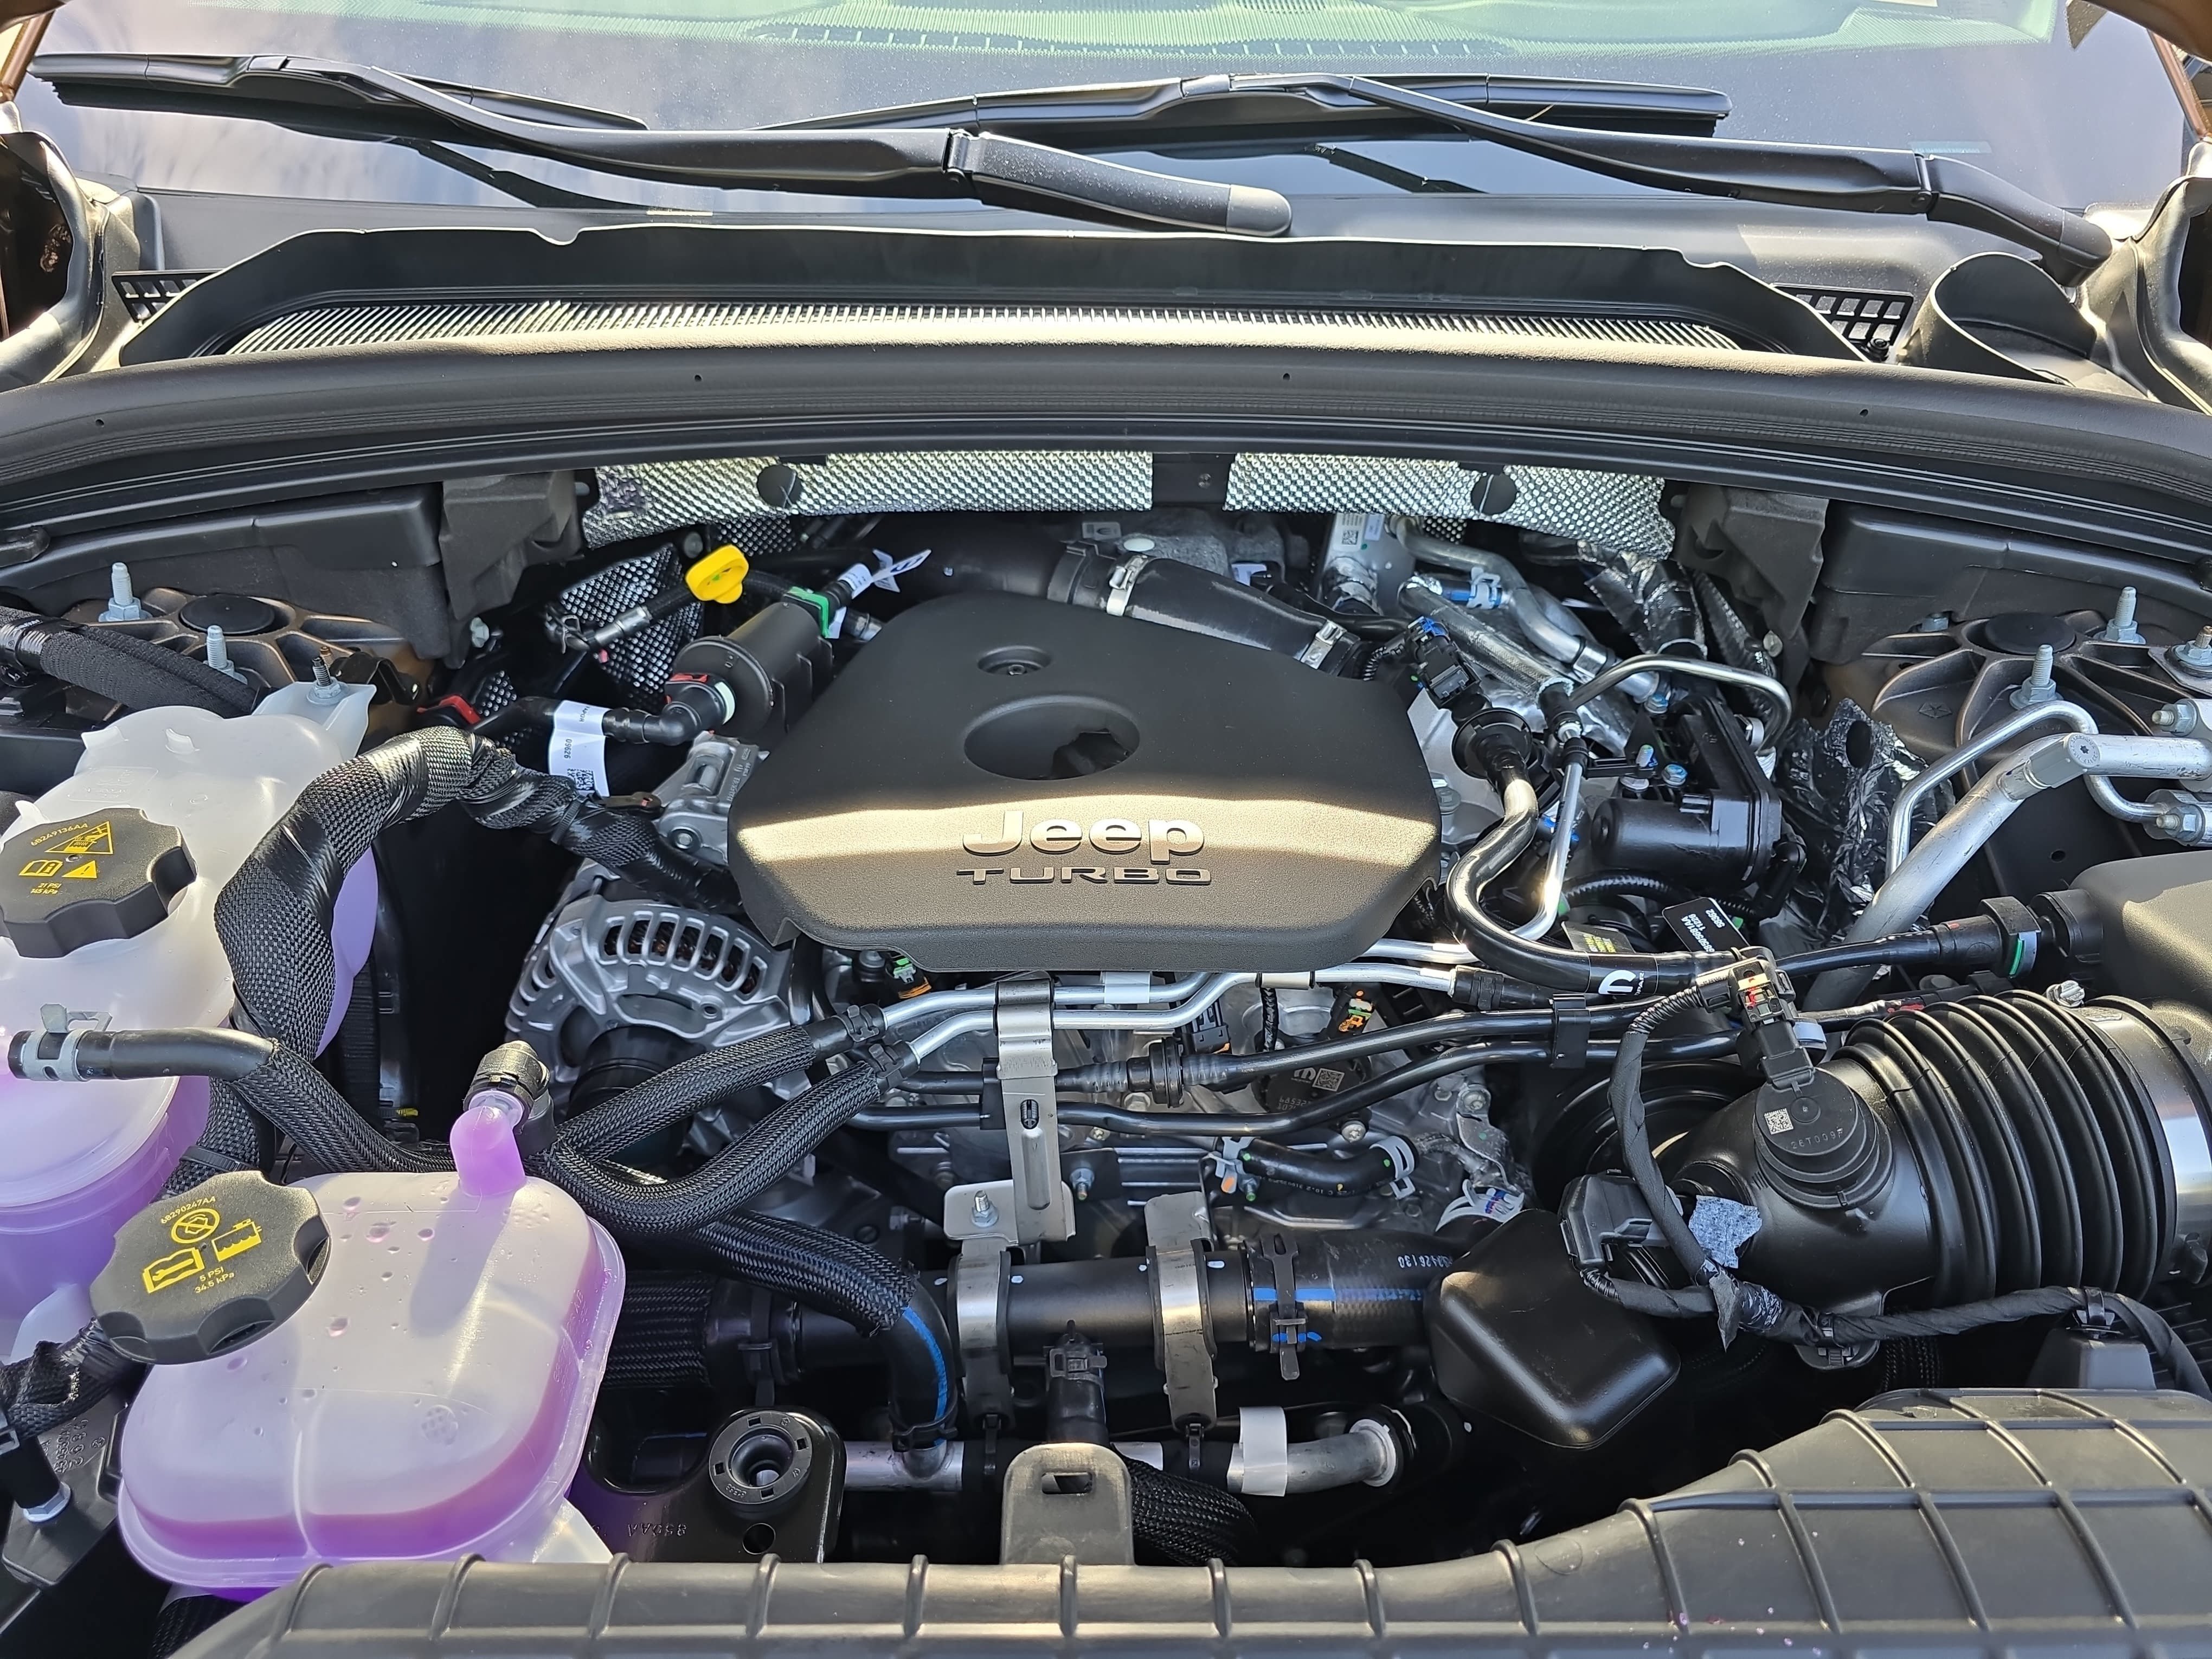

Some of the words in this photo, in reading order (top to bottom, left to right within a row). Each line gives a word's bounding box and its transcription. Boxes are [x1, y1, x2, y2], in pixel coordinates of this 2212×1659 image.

[564, 738, 573, 759] 09626
[30, 823, 88, 846] 68249136AA
[962, 810, 1205, 865] Jeep
[956, 866, 1212, 885] TURBO
[1706, 909, 1725, 928] 58362
[1681, 916, 1715, 953] 68505681AA
[160, 1196, 216, 1224] 68290247AA
[195, 1282, 214, 1293] 34.5
[216, 1272, 235, 1284] kPa
[208, 1266, 224, 1278] PSI
